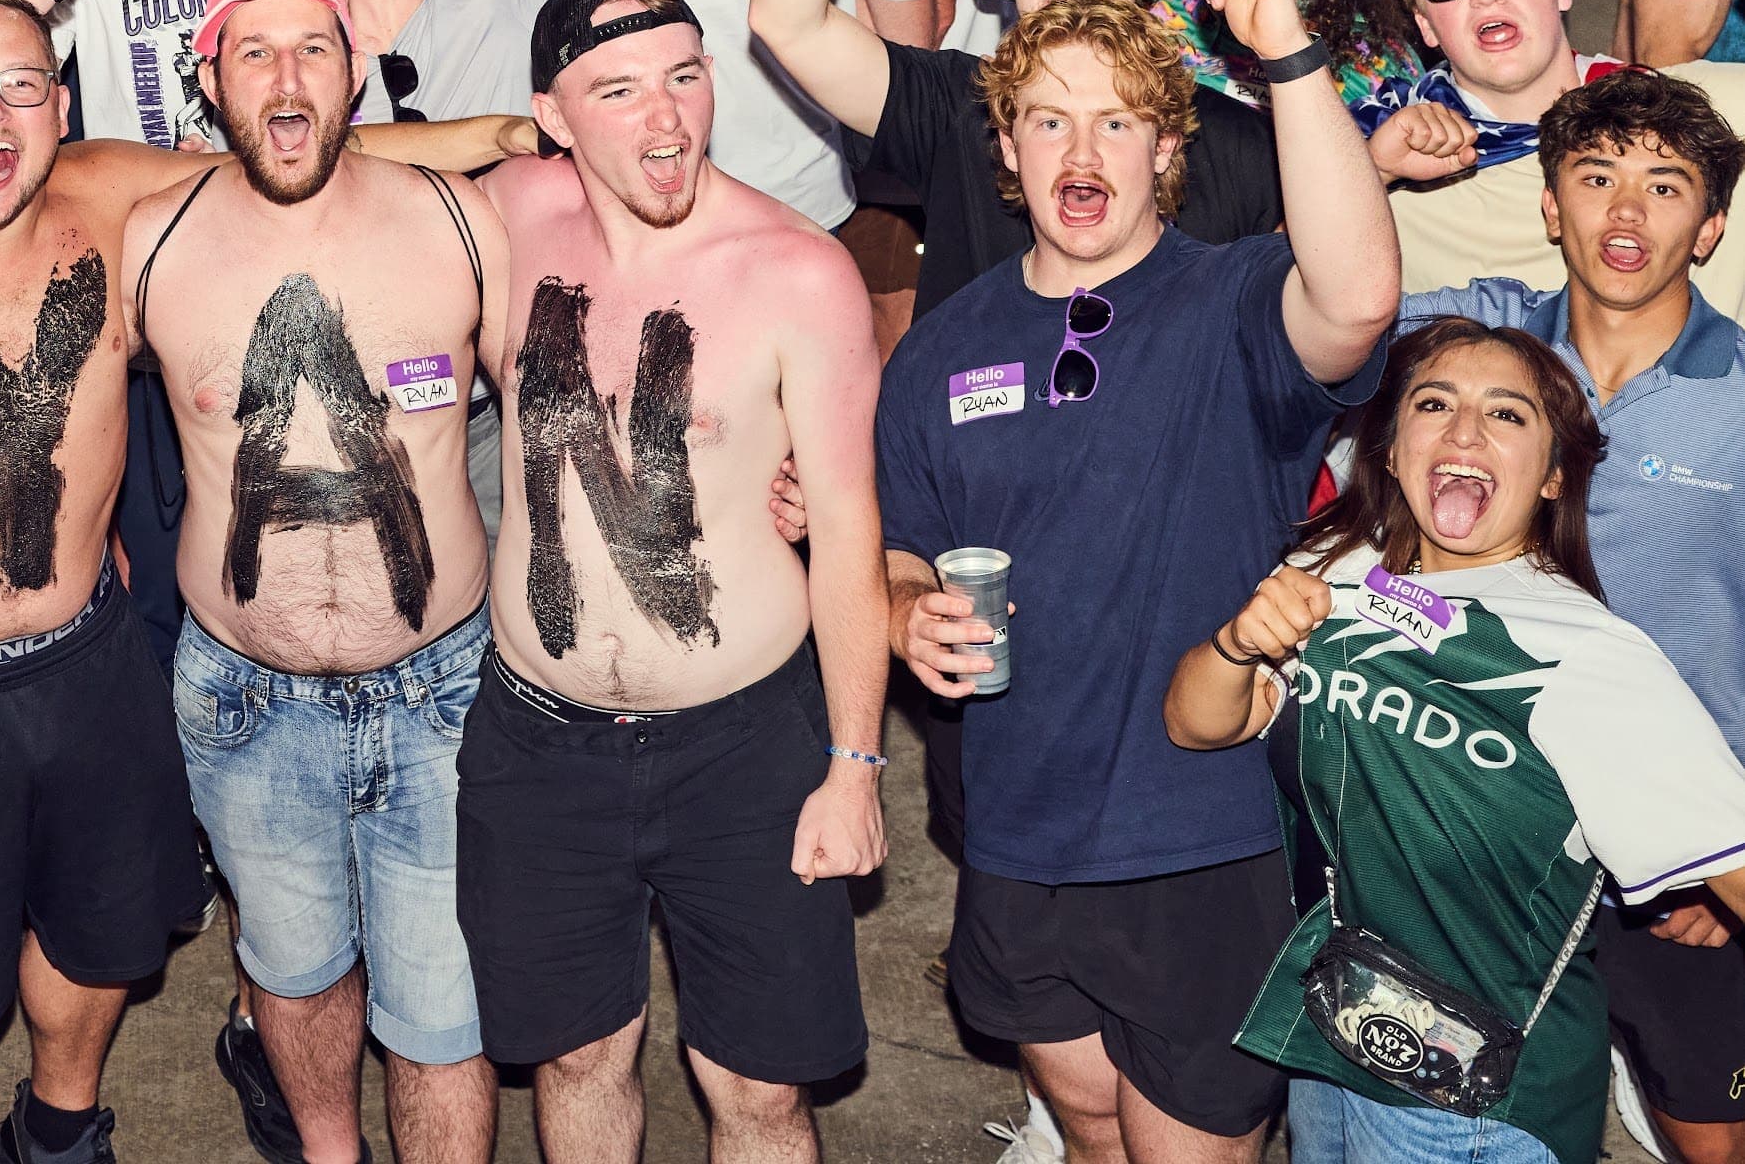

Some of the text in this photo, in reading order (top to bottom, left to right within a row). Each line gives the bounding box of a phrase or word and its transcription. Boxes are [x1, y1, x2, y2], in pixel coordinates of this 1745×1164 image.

[403, 358, 438, 376] Hello
[966, 367, 1005, 386] Hello
[403, 380, 448, 406] RYAN
[1671, 464, 1693, 476] BMW
[1669, 472, 1734, 492] CHAMPIONSHIP
[1385, 576, 1433, 607] Hello
[1399, 597, 1417, 609] name
[1367, 593, 1433, 639] RYAN
[1553, 937, 1578, 979] JACK
[1386, 1025, 1408, 1041] OLD
[1370, 1044, 1402, 1067] BRAND
